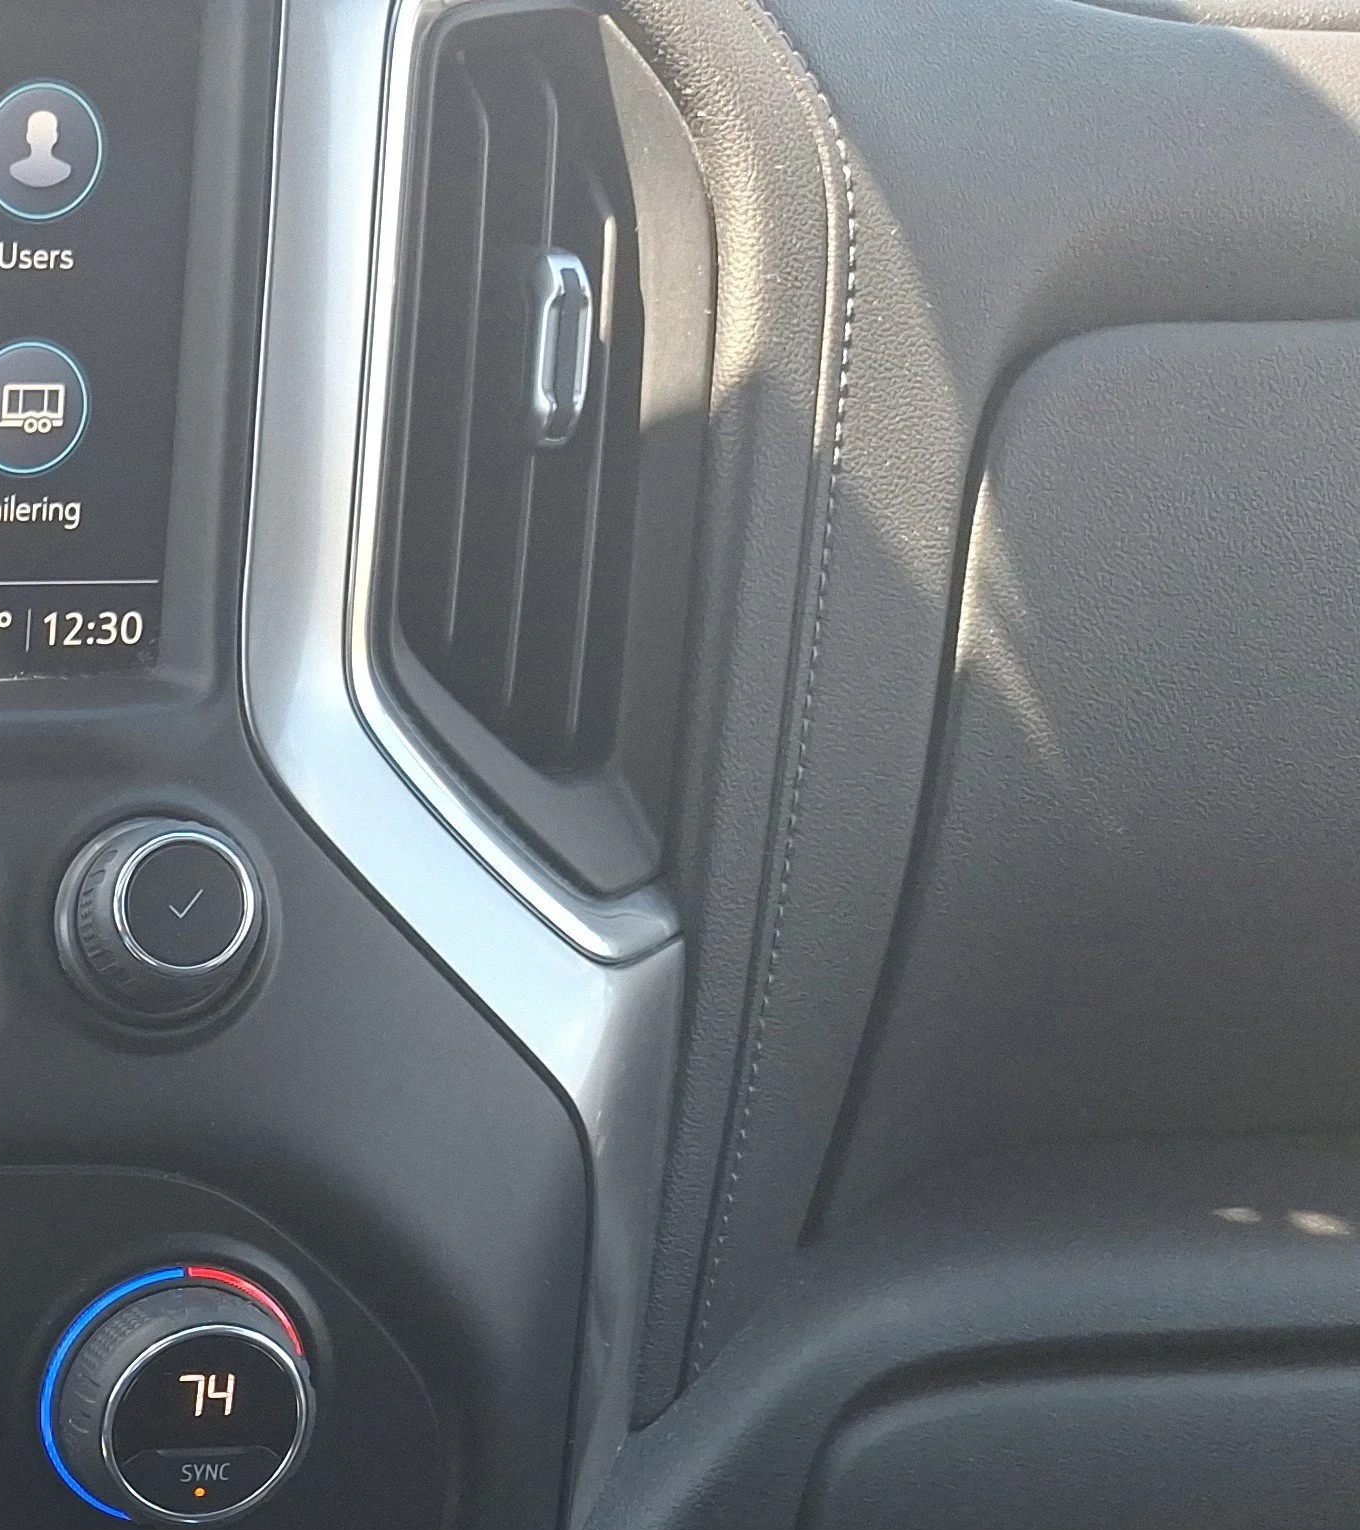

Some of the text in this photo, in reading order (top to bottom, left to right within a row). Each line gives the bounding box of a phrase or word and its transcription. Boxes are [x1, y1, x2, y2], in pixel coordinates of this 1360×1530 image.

[43, 611, 143, 647] 12:30
[180, 1373, 235, 1417] 74
[181, 1463, 230, 1482] SYNC
